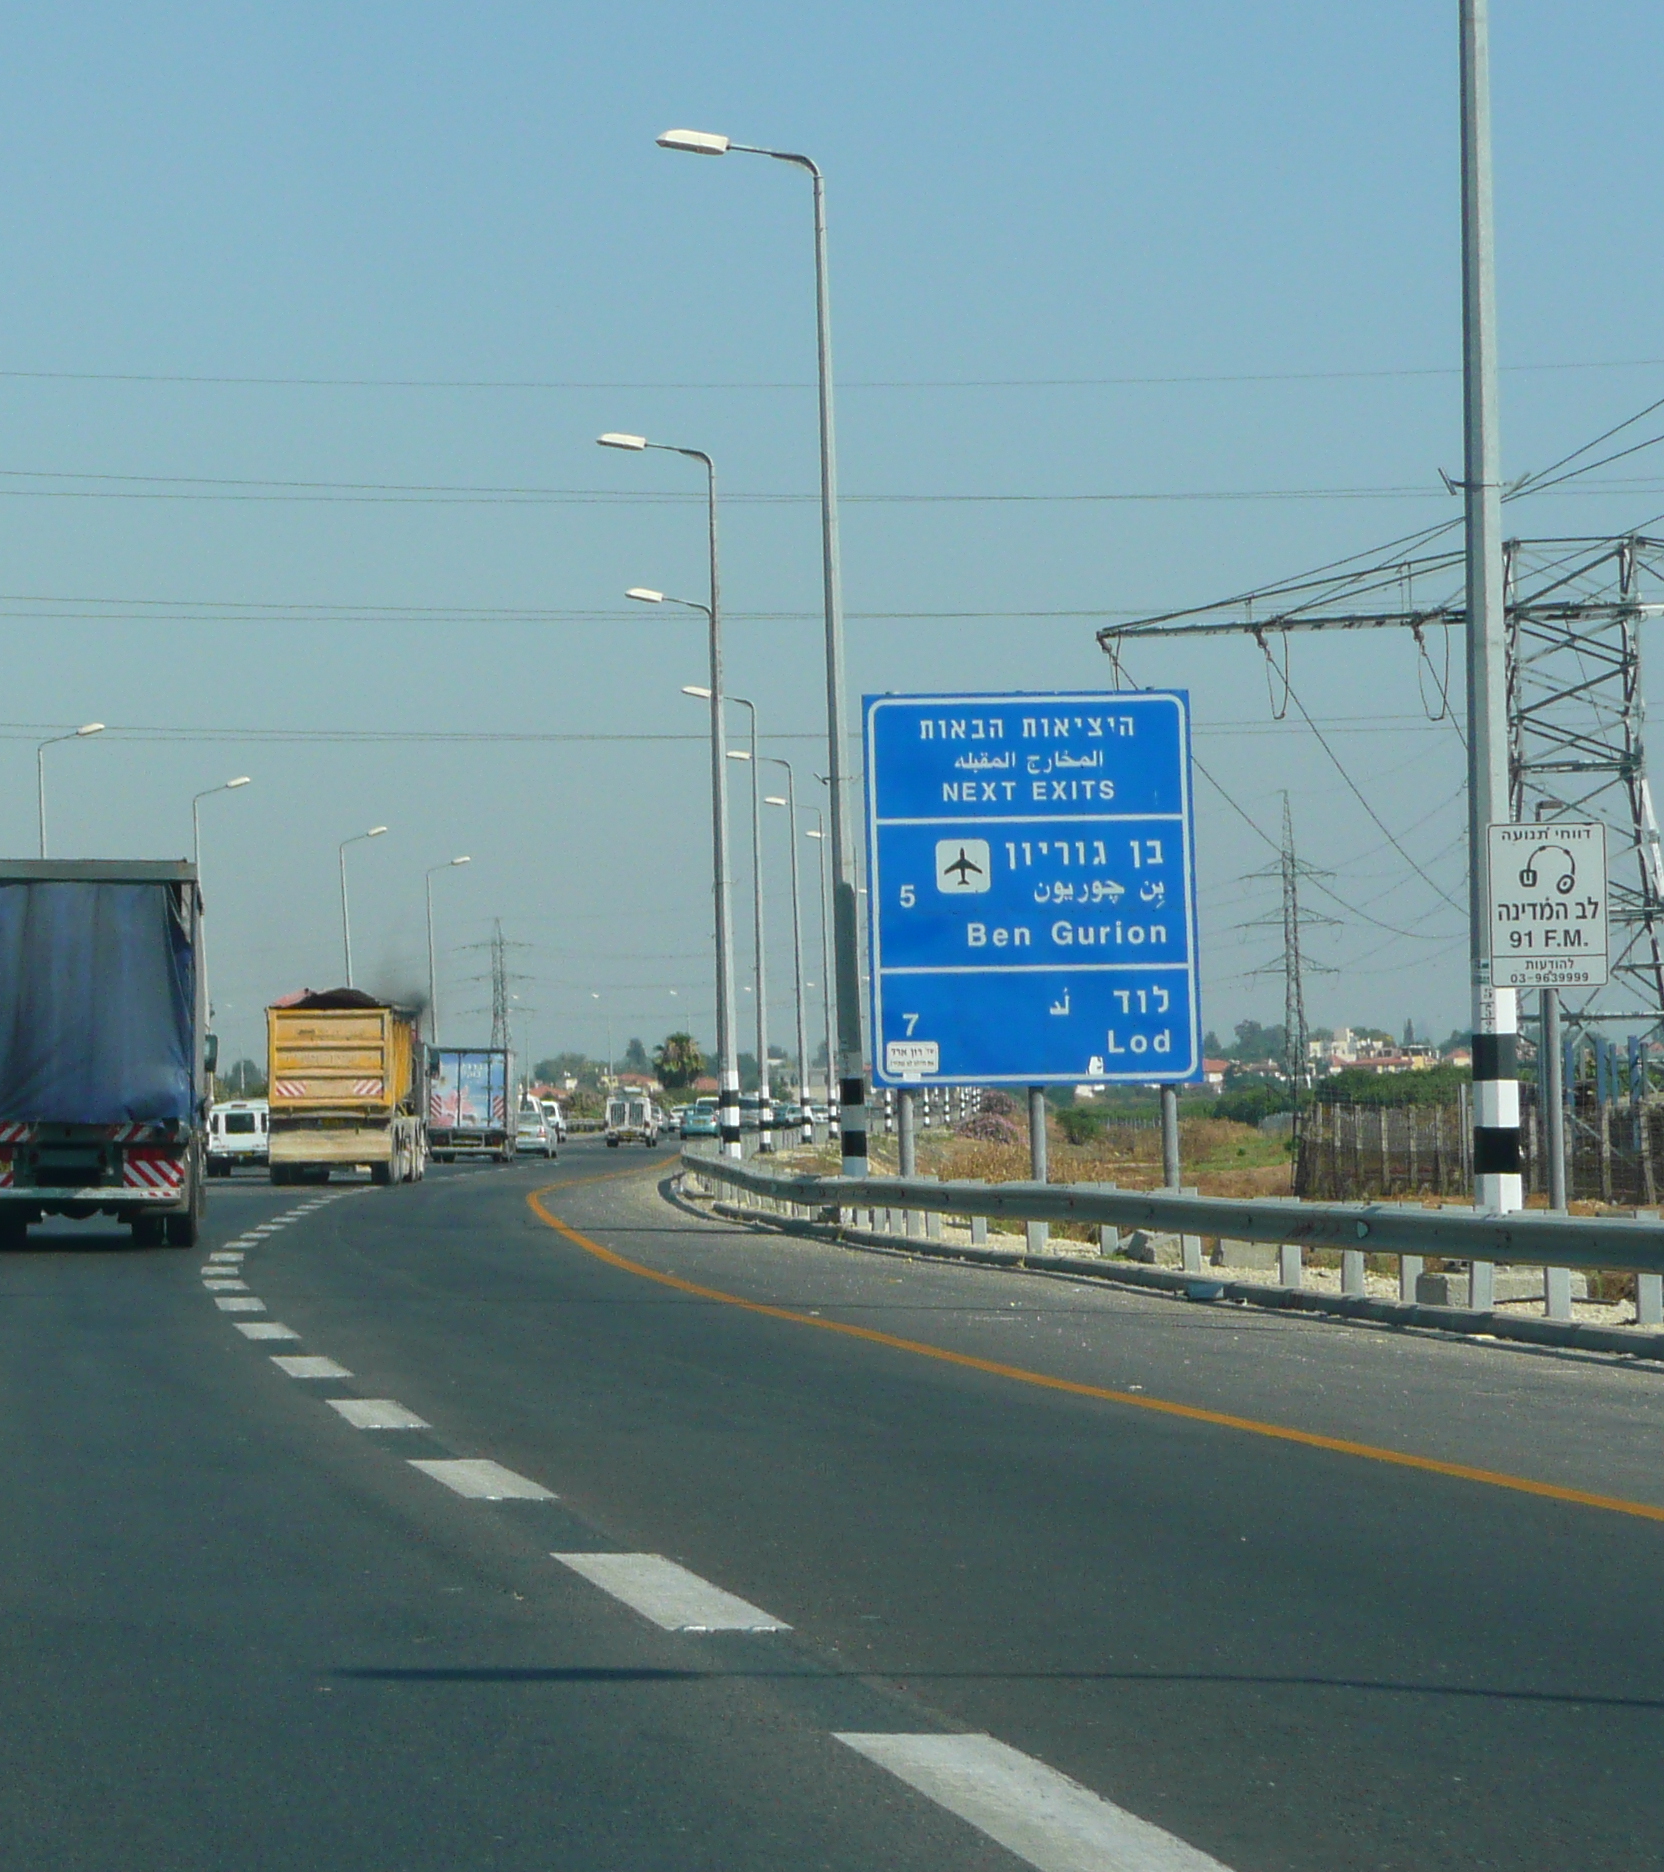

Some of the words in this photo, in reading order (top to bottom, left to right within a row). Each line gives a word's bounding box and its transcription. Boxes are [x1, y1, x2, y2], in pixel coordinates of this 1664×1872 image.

[920, 718, 1004, 740] הבאות
[1022, 716, 1134, 737] היציאות
[1026, 749, 1104, 774] المخارج
[942, 781, 1016, 802] NEXT
[1032, 780, 1115, 800] EXITS
[1501, 830, 1548, 841] תנועה
[1555, 829, 1591, 839] דווחי
[1005, 840, 1107, 870] גוריון
[1130, 839, 1164, 868] בן
[899, 884, 916, 909] 5
[1575, 896, 1600, 920] לב
[1497, 901, 1568, 922] המדינה
[967, 923, 1032, 948] Ben
[1051, 919, 1168, 945] Gurion
[1509, 930, 1533, 948] 91
[1544, 929, 1589, 948] F.M.
[1524, 958, 1575, 972] להודעות
[1510, 972, 1589, 984] 03-9639999
[1113, 985, 1170, 1015] לוד
[902, 1013, 919, 1037] 7
[1108, 1029, 1172, 1054] Lod
